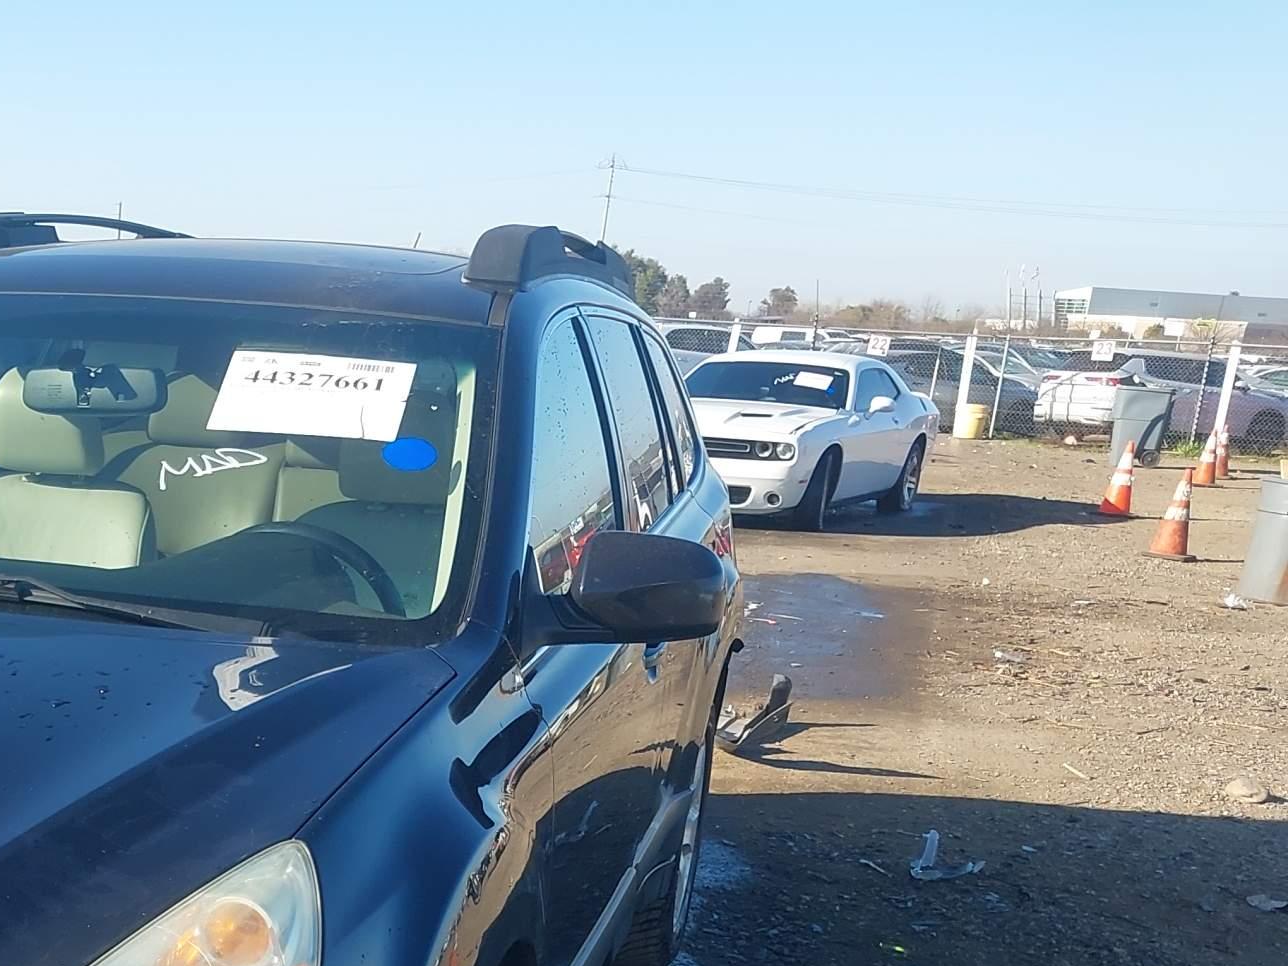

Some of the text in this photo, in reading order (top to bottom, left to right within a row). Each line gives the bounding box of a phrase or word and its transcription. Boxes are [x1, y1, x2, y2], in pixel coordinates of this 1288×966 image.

[871, 337, 888, 353] 22
[1095, 342, 1112, 355] 23
[244, 369, 384, 392] 44327661
[159, 447, 268, 491] MAD
